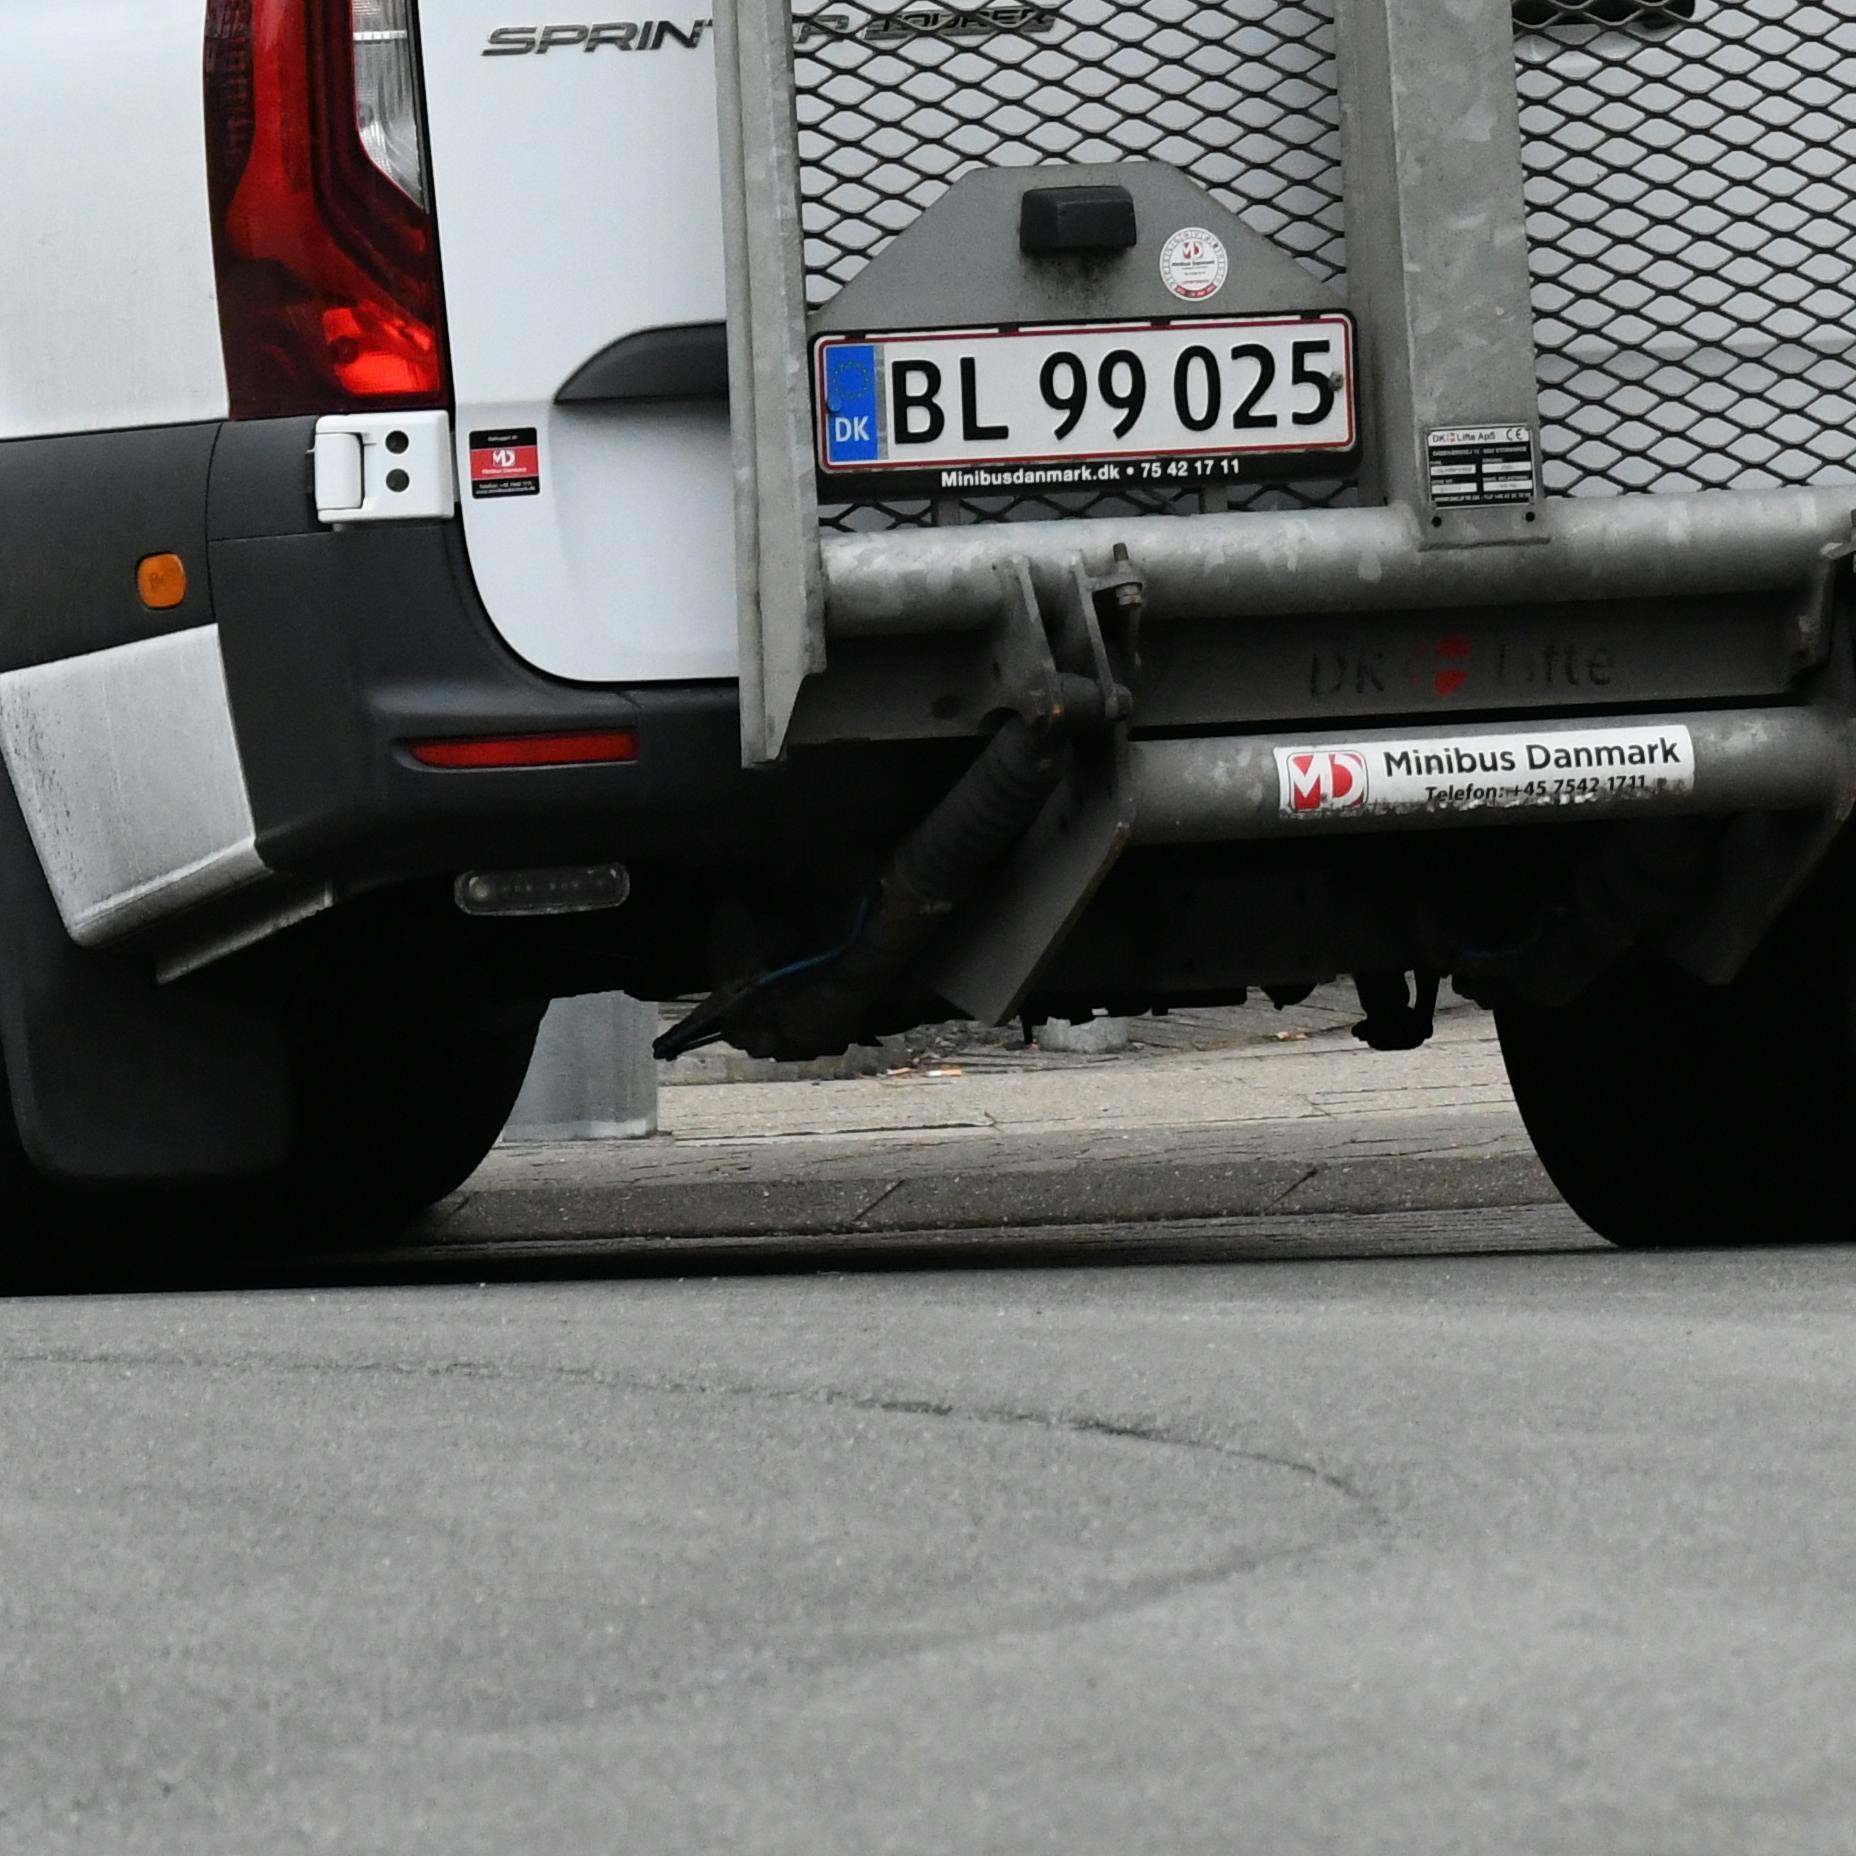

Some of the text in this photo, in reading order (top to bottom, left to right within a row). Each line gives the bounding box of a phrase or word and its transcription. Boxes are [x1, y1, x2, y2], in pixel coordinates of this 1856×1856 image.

[890, 338, 1335, 446] BL 99 025
[834, 416, 871, 443] DK
[940, 458, 1240, 488] Minibusdanmark.dk 75 42 17 11
[1383, 747, 1516, 777] Minibus
[1526, 737, 1681, 770] Danmark
[1425, 775, 1646, 803] Telefon: +45 7542 1711
